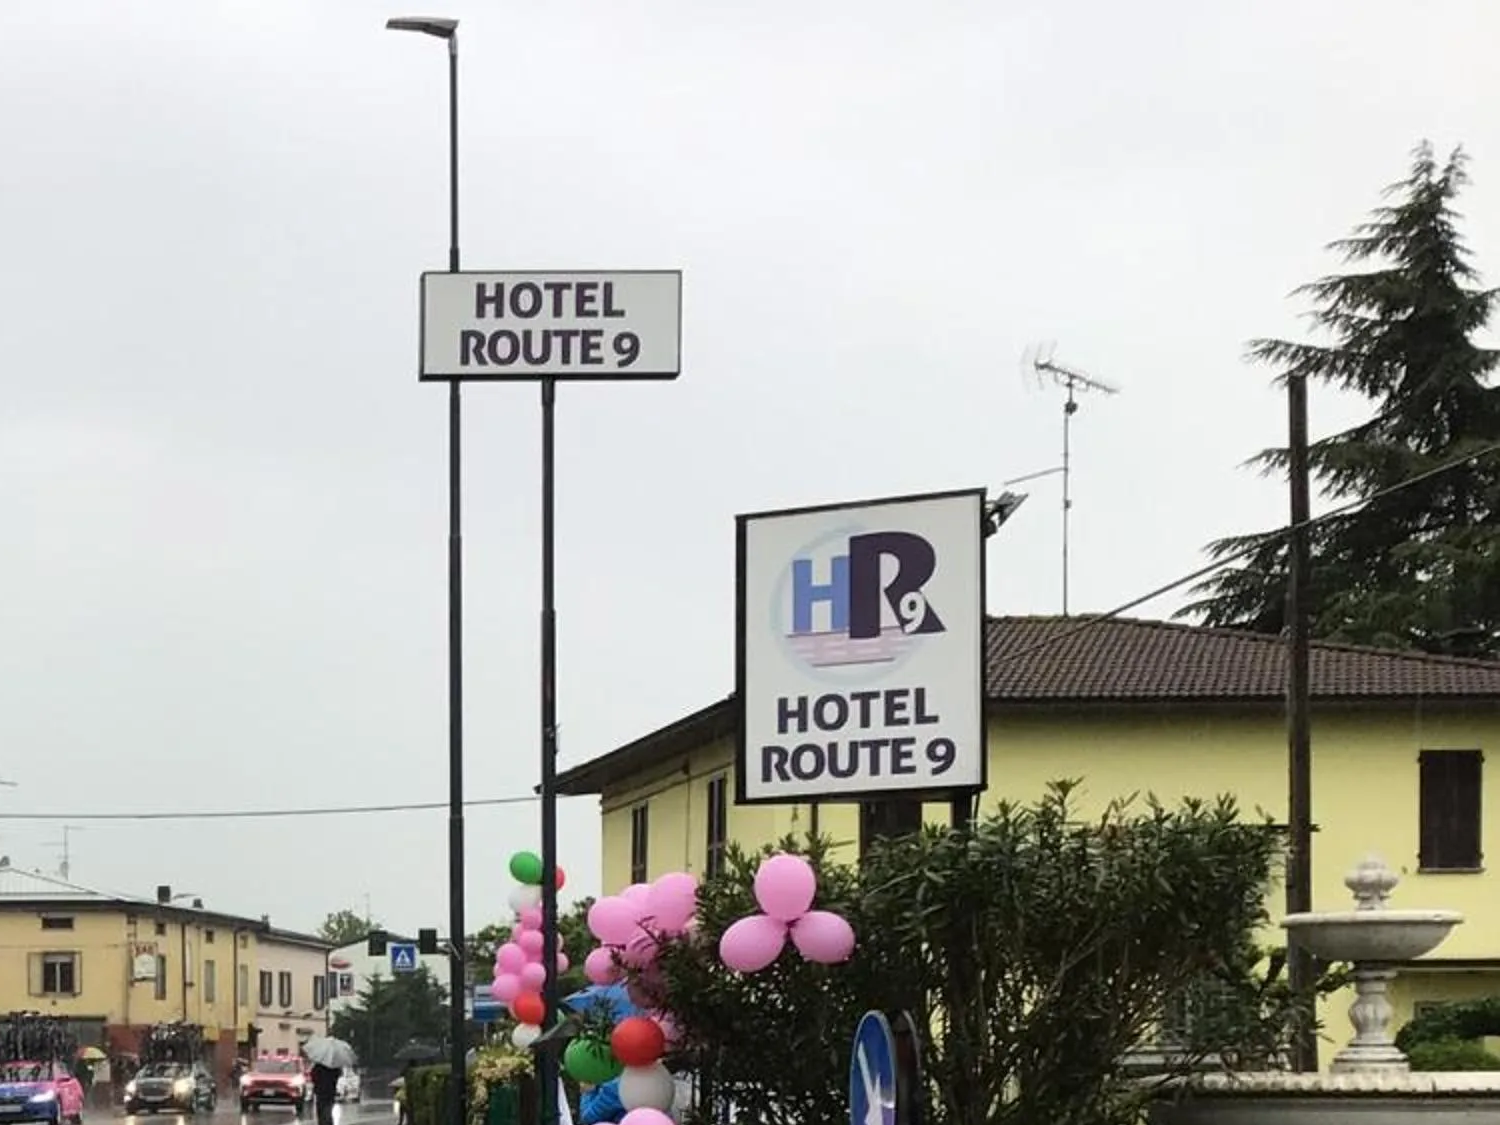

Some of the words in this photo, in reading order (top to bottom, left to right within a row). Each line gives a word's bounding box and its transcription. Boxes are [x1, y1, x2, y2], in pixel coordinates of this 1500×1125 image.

[474, 281, 626, 319] HOTEL
[459, 328, 605, 366] ROUTE
[612, 331, 641, 368] 9
[777, 687, 939, 734] HOTEL
[760, 737, 917, 783] ROUTE
[925, 738, 957, 776] 9
